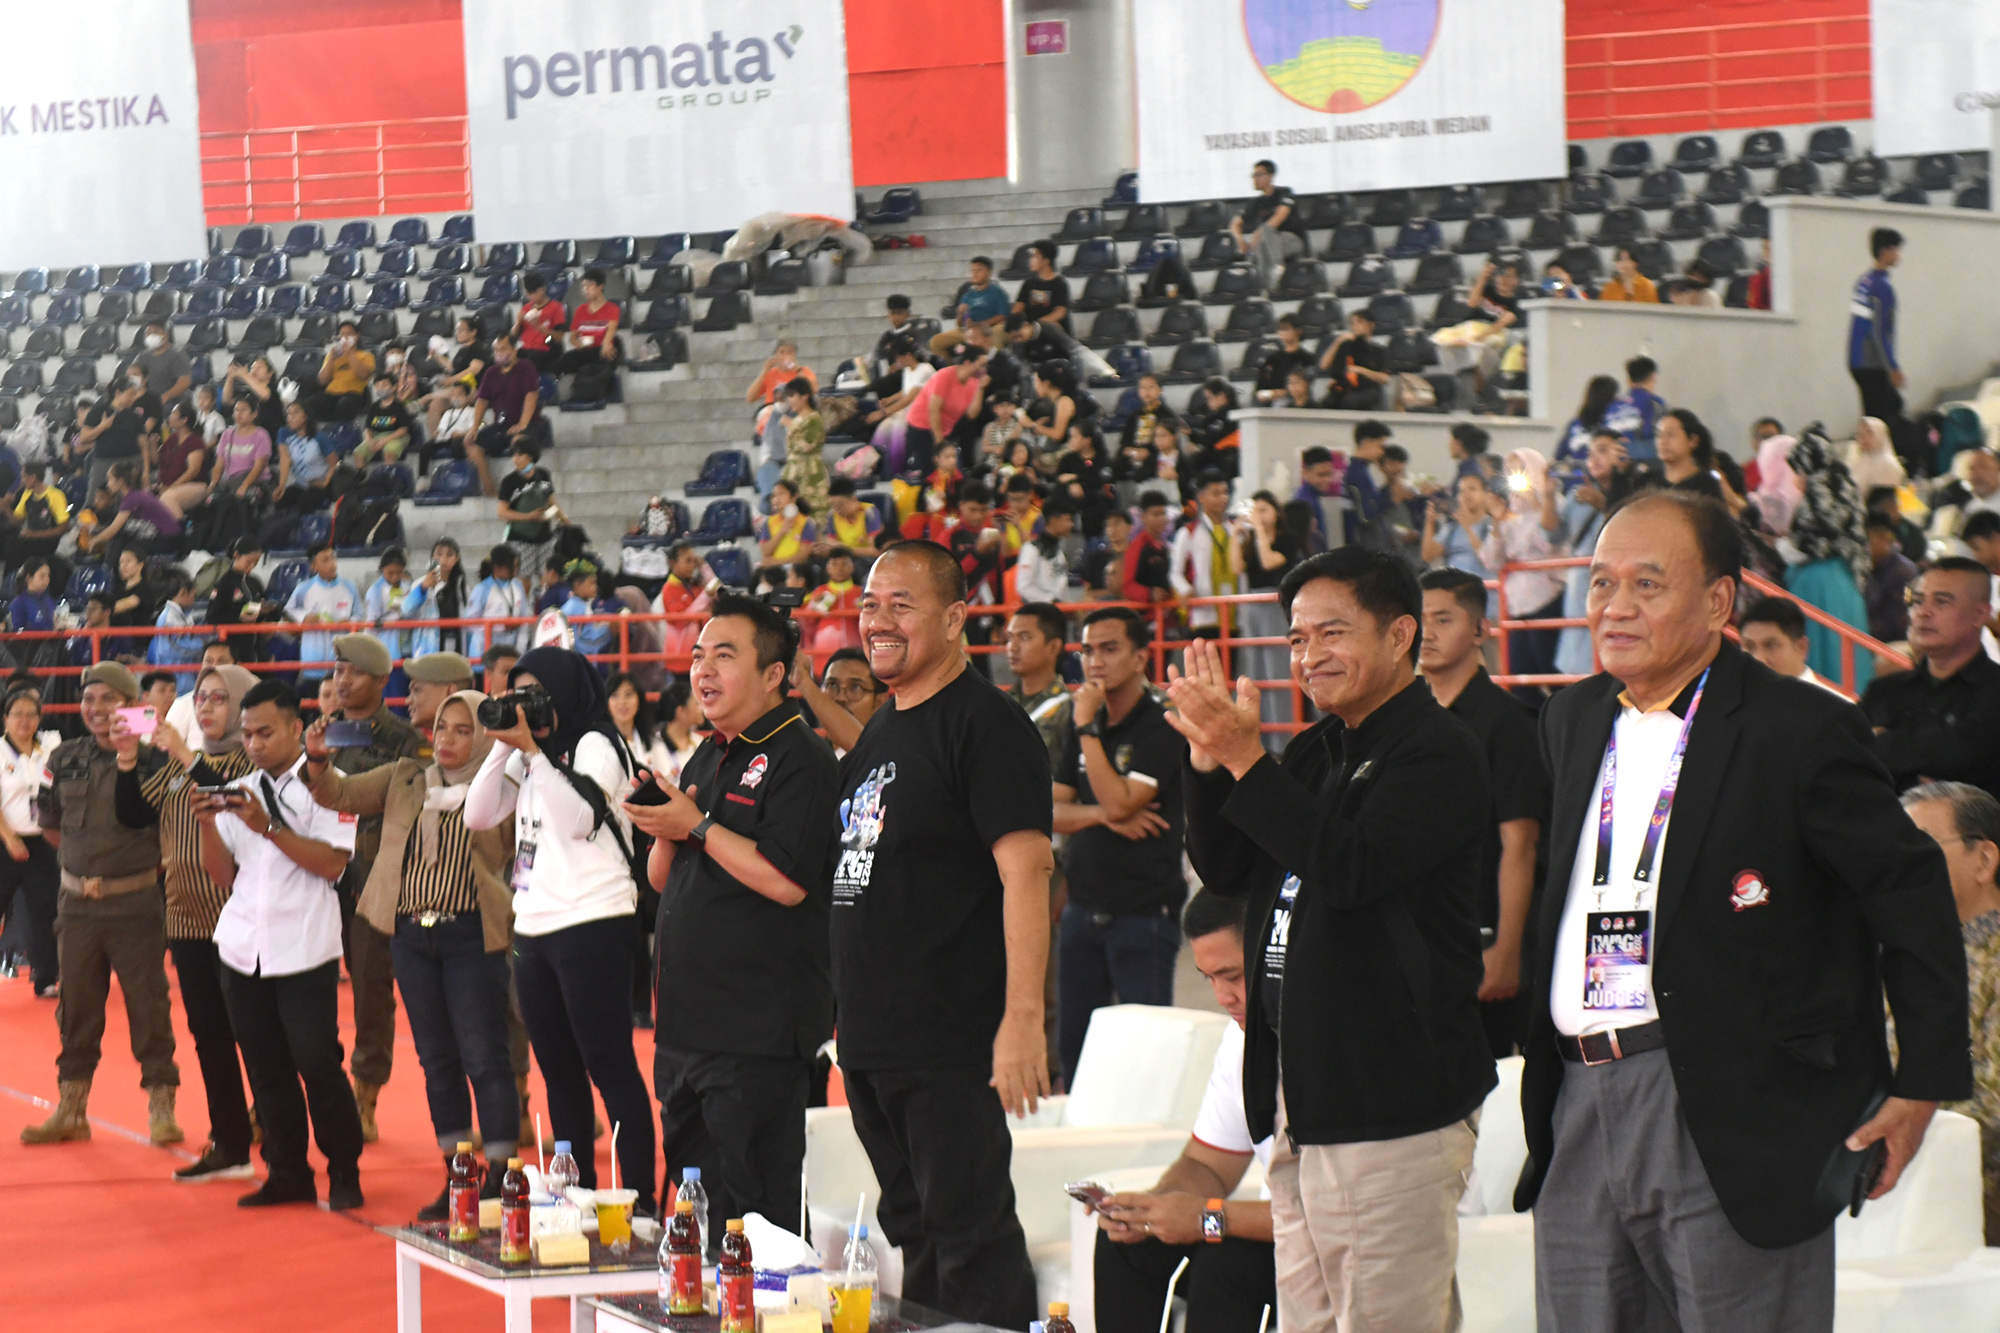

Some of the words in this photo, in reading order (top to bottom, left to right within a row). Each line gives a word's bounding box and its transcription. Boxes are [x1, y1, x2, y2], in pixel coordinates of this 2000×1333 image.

[503, 30, 776, 120] permata
[31, 93, 169, 134] MESTIKA
[656, 88, 772, 110] GROUP
[1204, 131, 1271, 150] YAYASAN
[1275, 126, 1330, 146] SOSIAL
[1433, 115, 1491, 134] MEDAN
[860, 850, 875, 887] 2023
[1583, 989, 1646, 1008] JUDGES
